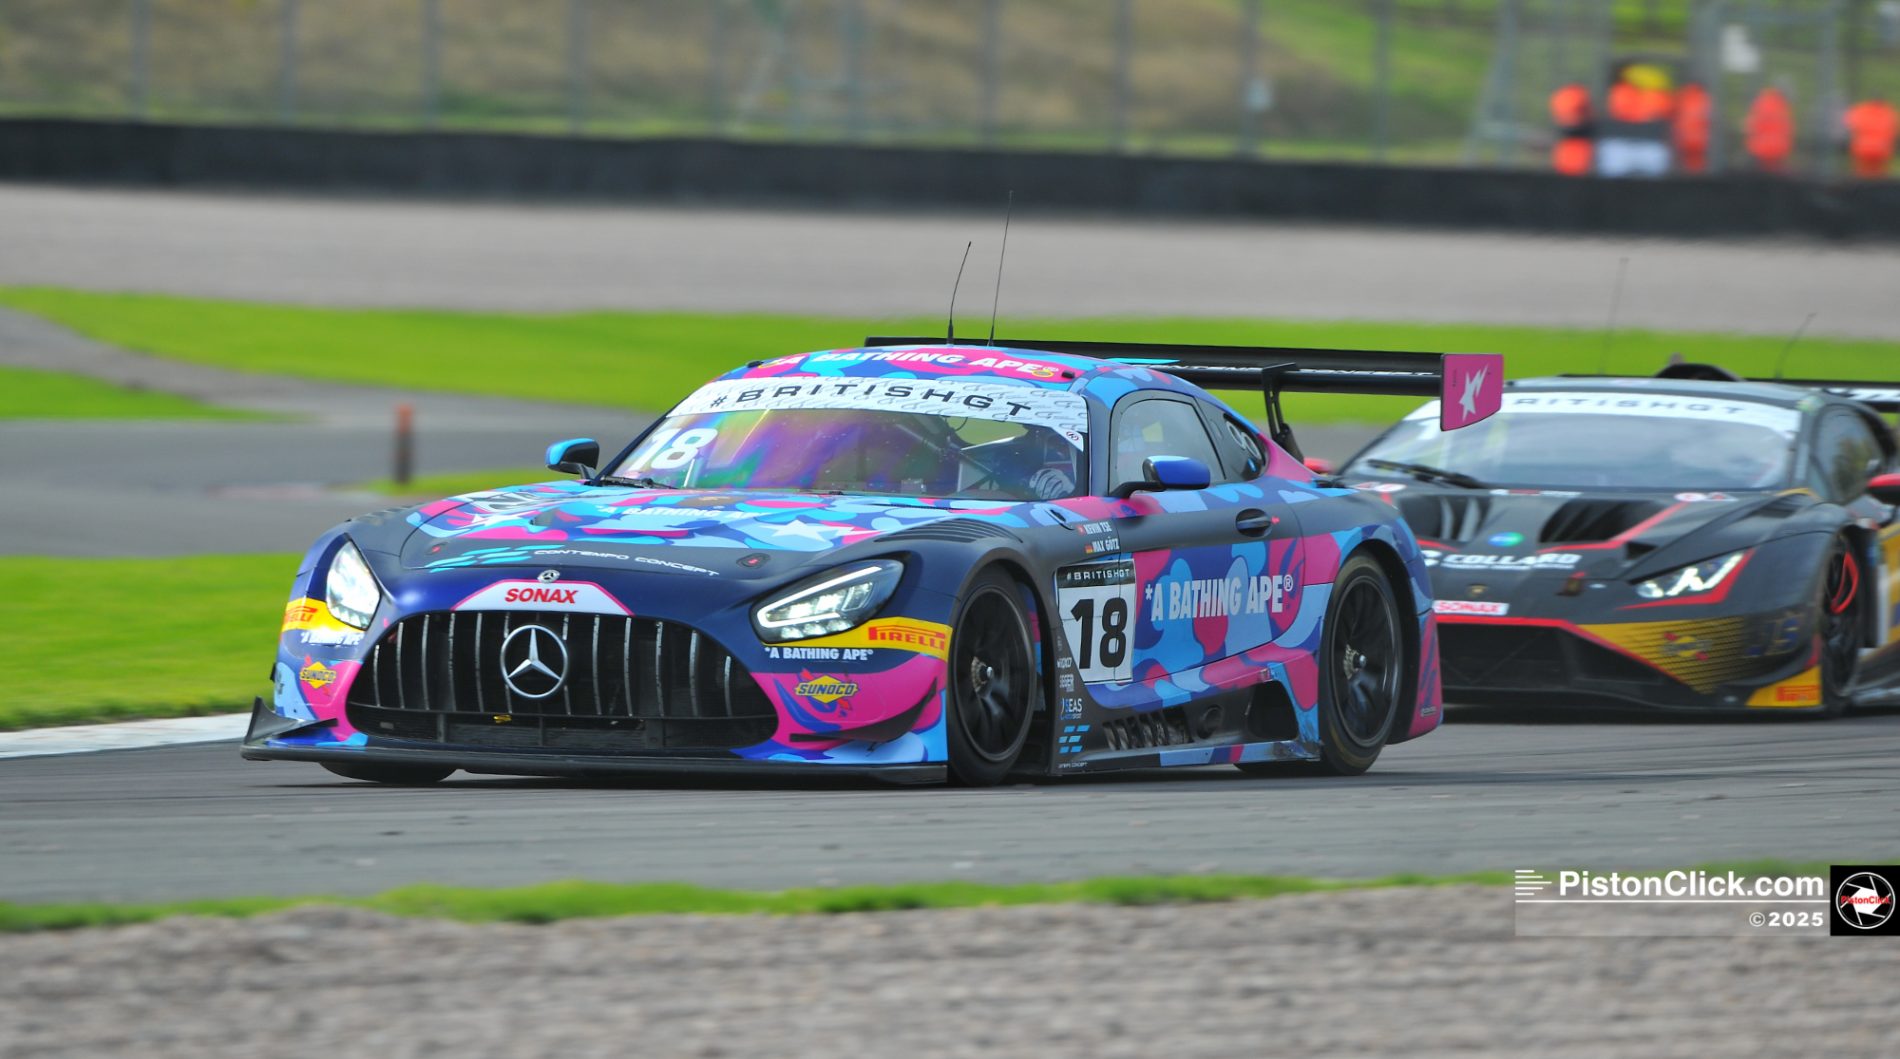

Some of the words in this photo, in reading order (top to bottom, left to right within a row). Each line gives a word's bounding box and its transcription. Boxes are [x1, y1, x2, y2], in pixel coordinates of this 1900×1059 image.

[812, 350, 966, 366] BATHING
[709, 383, 1031, 416] #BRITISHGT
[627, 427, 719, 472] 18
[1083, 522, 1102, 534] KEVIN
[1100, 521, 1112, 532] TSE
[1092, 540, 1105, 552] MAX
[533, 549, 630, 561] CONTEMPO
[634, 557, 720, 577] CONCEPT
[1442, 553, 1583, 566] COLLARD
[1066, 568, 1130, 581] #BRITISHGT
[505, 588, 580, 604] SONAX
[1169, 578, 1242, 621] BATHING
[868, 625, 946, 650] PIRELLI
[1070, 597, 1128, 670] 18
[783, 647, 840, 660] BATHING
[798, 683, 856, 695] SUNOCO
